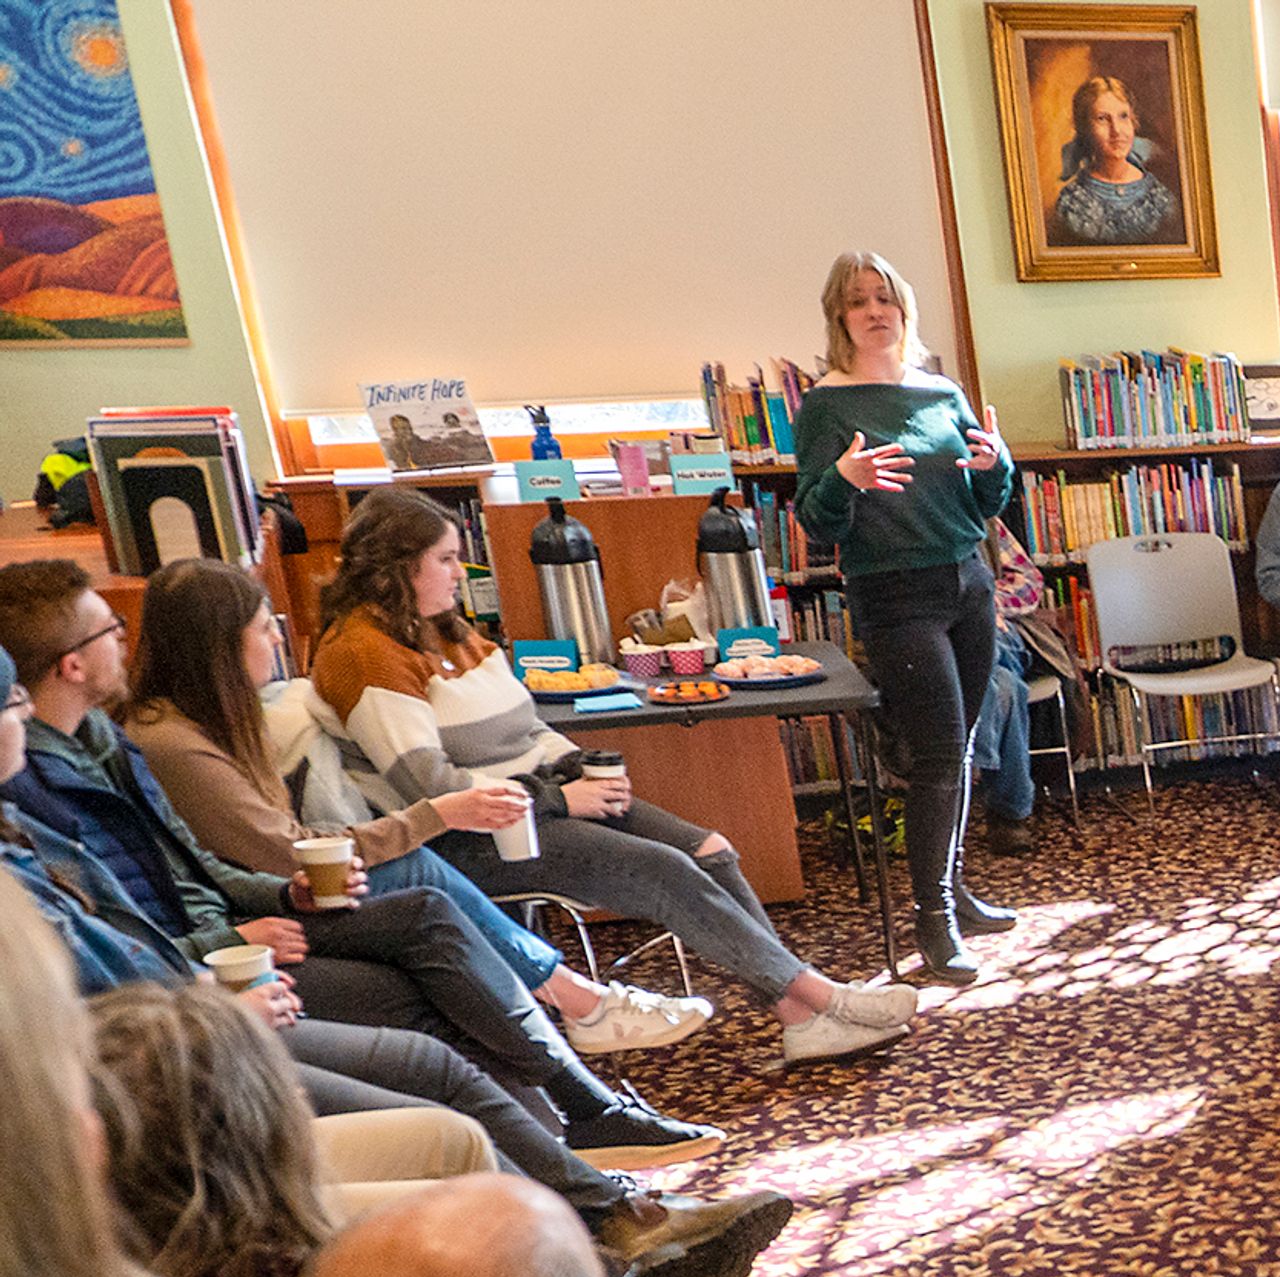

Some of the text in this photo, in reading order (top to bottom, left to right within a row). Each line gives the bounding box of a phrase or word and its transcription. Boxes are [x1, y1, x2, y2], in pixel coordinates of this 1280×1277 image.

[366, 379, 465, 408] INFINITE HOPE
[697, 469, 727, 479] Water
[529, 476, 562, 487] Coffee
